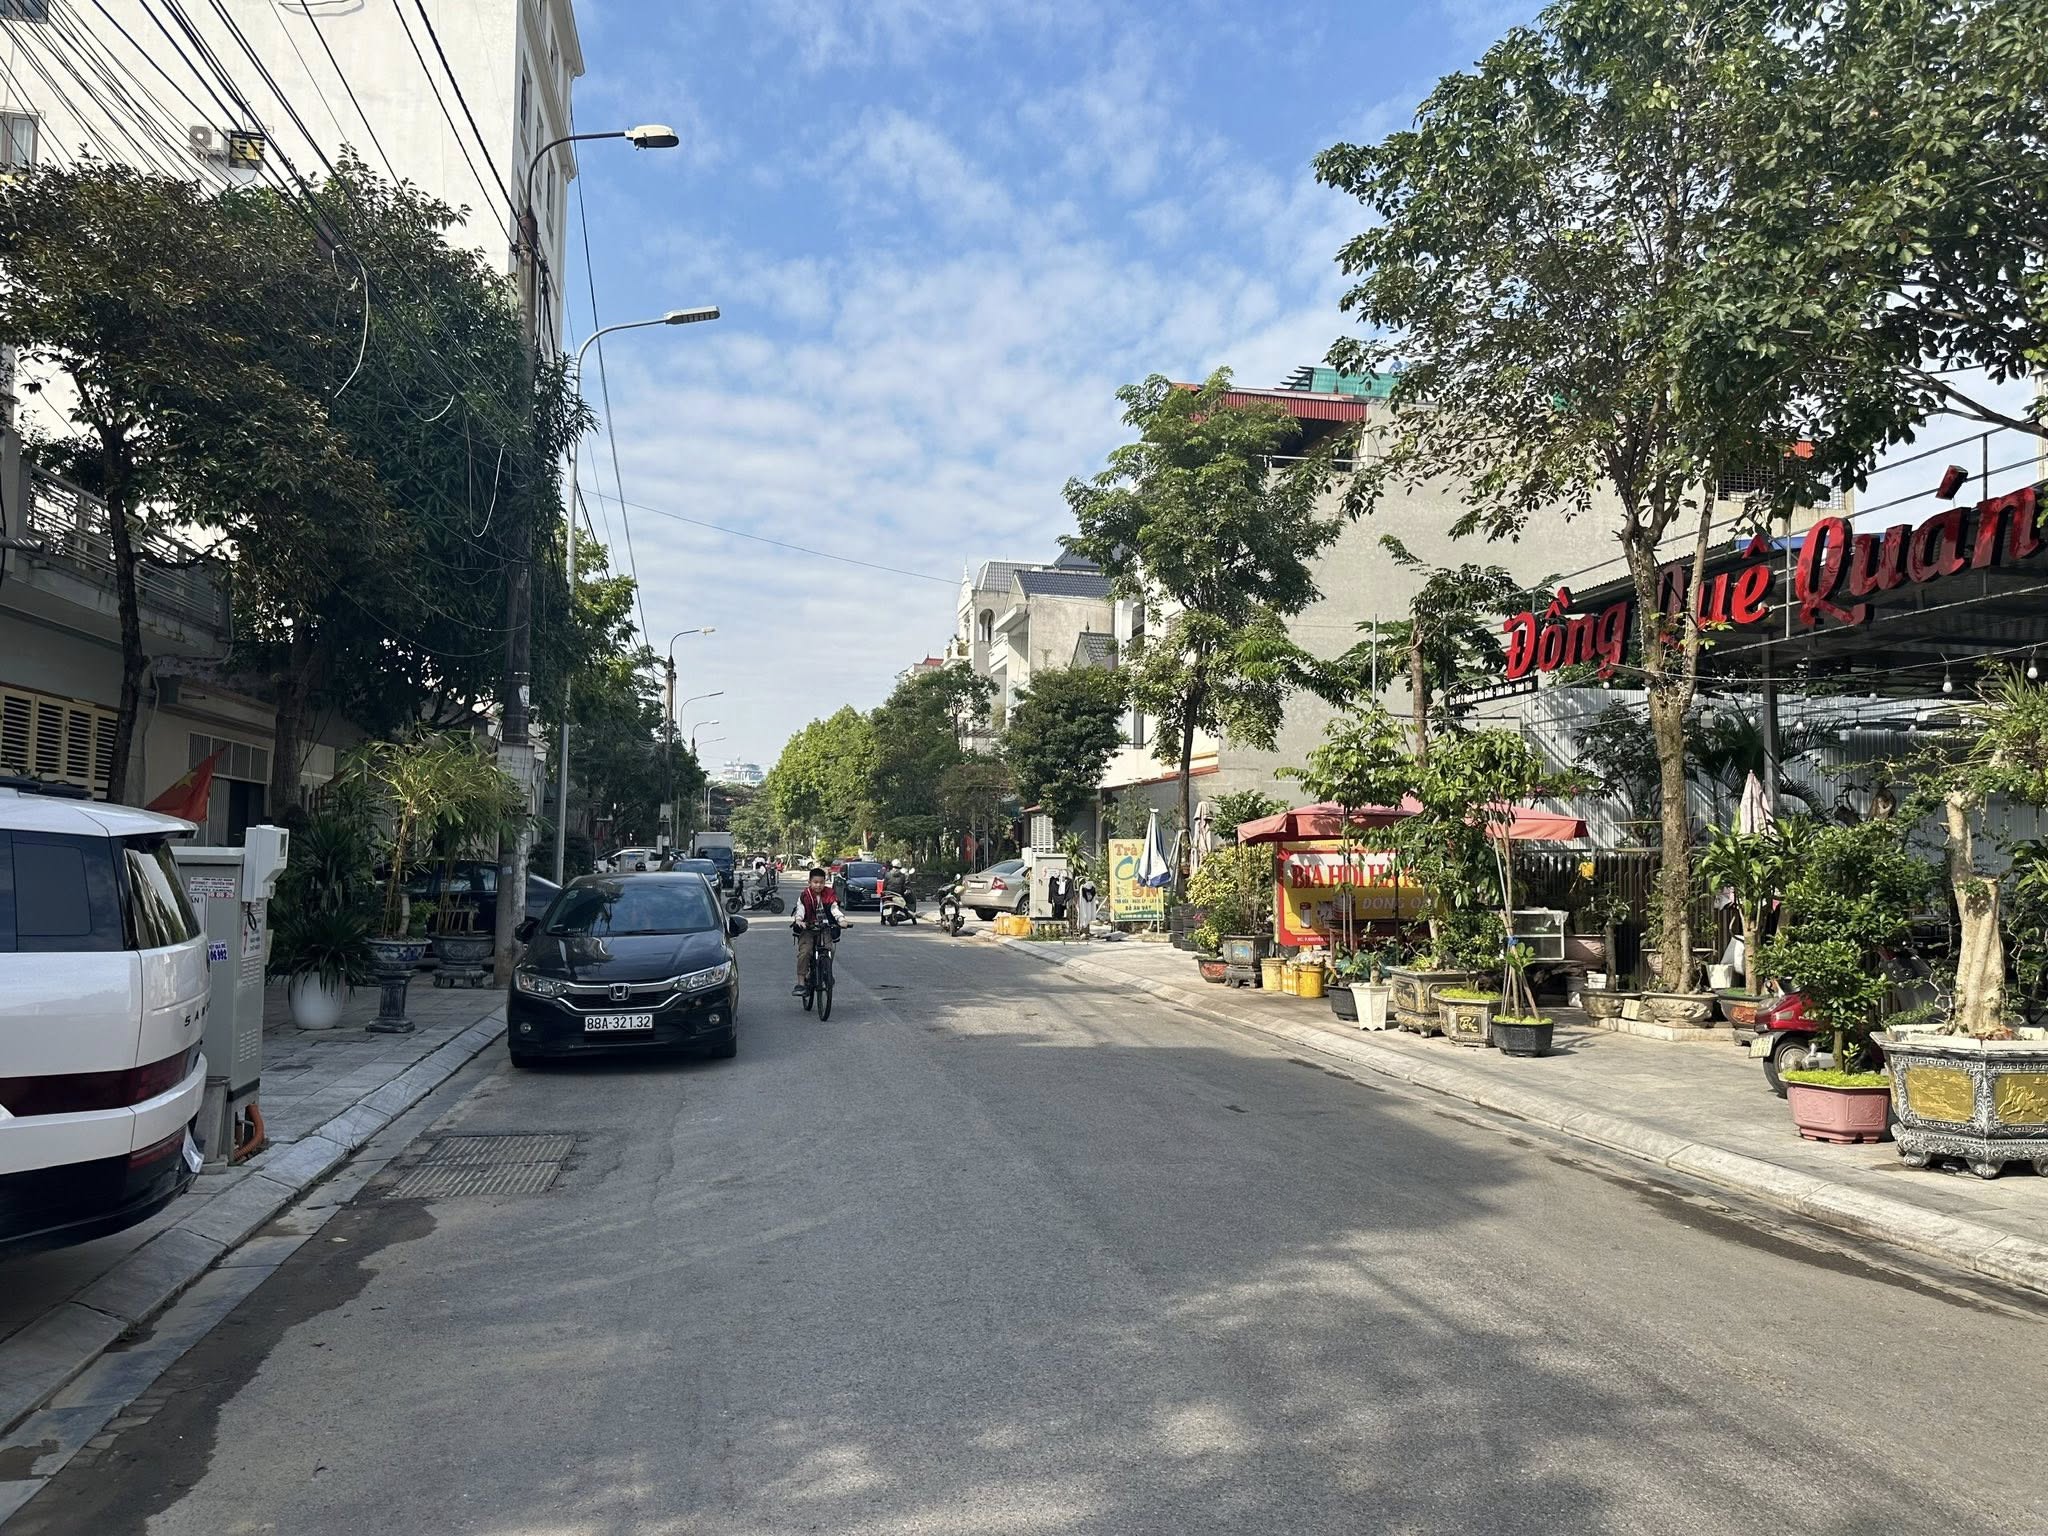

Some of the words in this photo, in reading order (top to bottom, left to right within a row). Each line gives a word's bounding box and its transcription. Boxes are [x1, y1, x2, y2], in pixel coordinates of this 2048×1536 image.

[1503, 586, 1633, 679] Đồng
[1794, 465, 2041, 626] Quán
[1114, 843, 1138, 856] Trà
[1290, 863, 1326, 889] BIA
[586, 1015, 651, 1029] 88A-321.32
